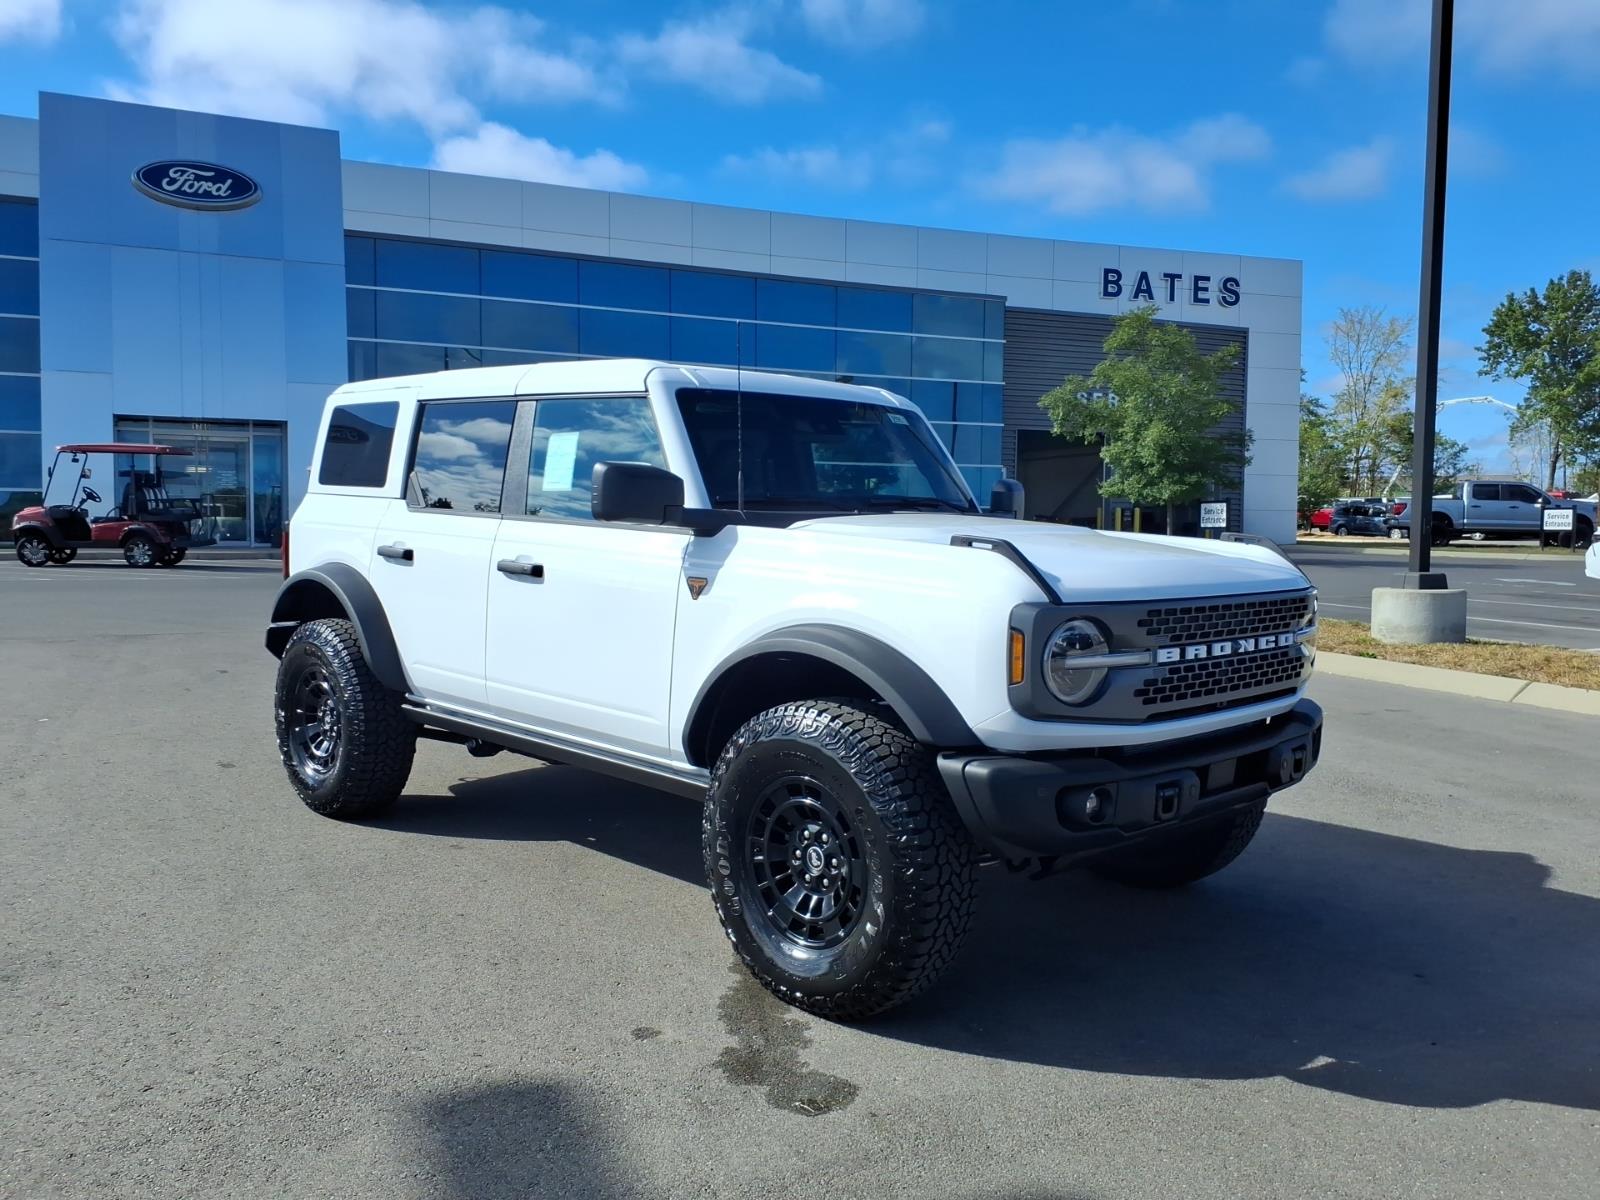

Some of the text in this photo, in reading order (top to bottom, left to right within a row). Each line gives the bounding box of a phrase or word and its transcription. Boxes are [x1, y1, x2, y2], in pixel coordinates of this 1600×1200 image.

[162, 166, 232, 197] Ford
[1101, 267, 1241, 307] BATES
[1203, 507, 1224, 515] Service
[1201, 516, 1226, 524] Entrance
[1547, 512, 1570, 520] Service
[1545, 520, 1572, 528] Entrance
[1156, 633, 1294, 663] BRONCO
